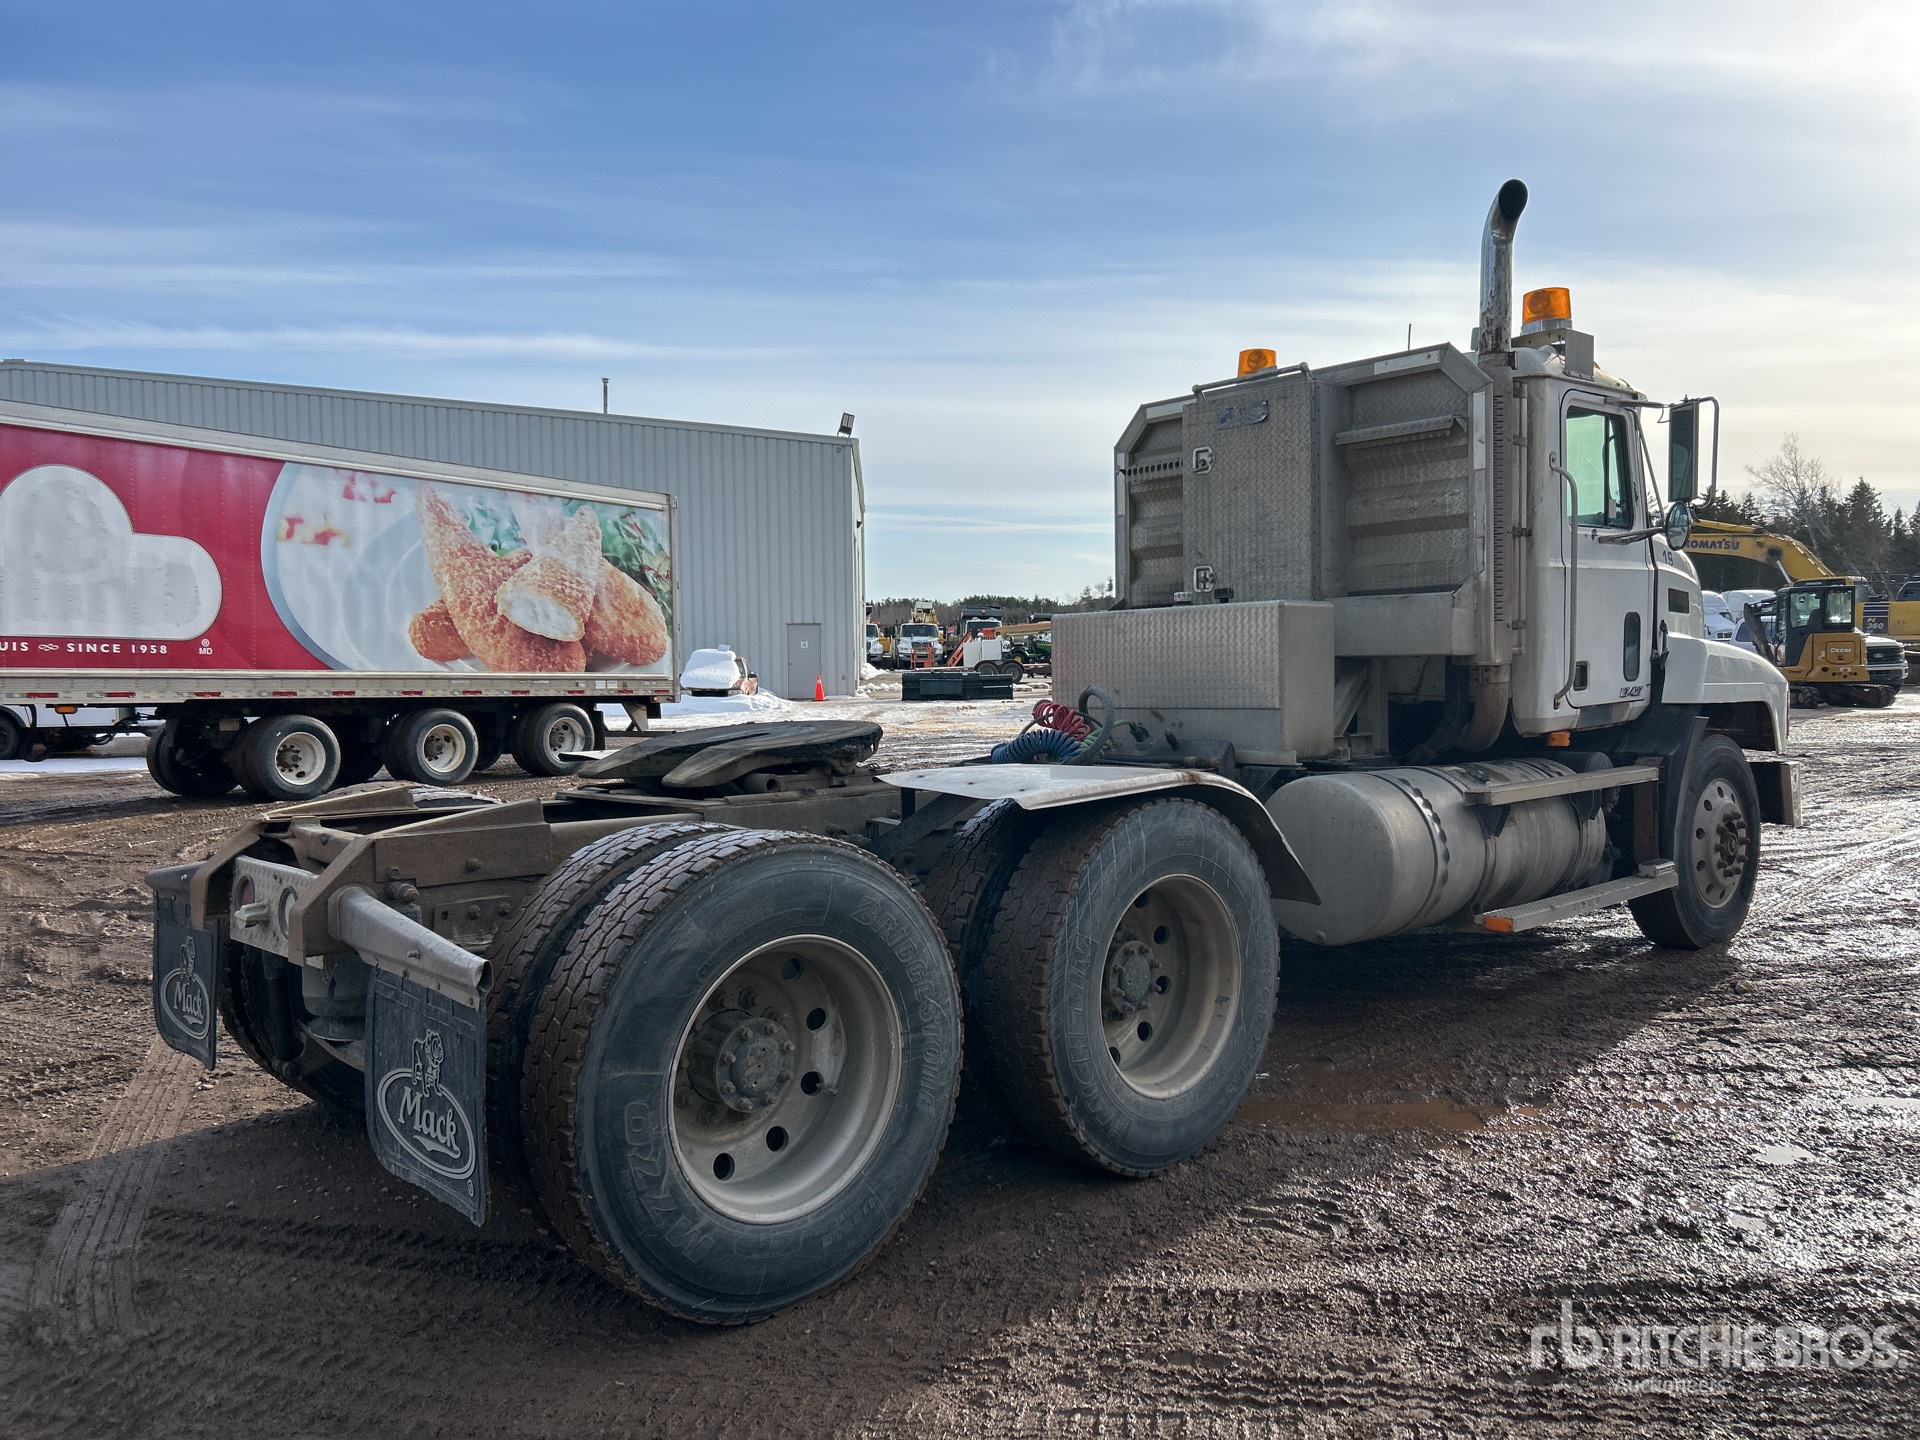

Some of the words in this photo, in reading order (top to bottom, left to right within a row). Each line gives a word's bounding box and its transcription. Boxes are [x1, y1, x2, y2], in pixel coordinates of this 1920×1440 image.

[1867, 622, 1884, 630] 360
[67, 643, 121, 653] SINCE
[131, 644, 168, 654] 1958
[199, 647, 213, 655] MD
[173, 981, 204, 1025] Mack
[397, 1086, 461, 1159] Mack
